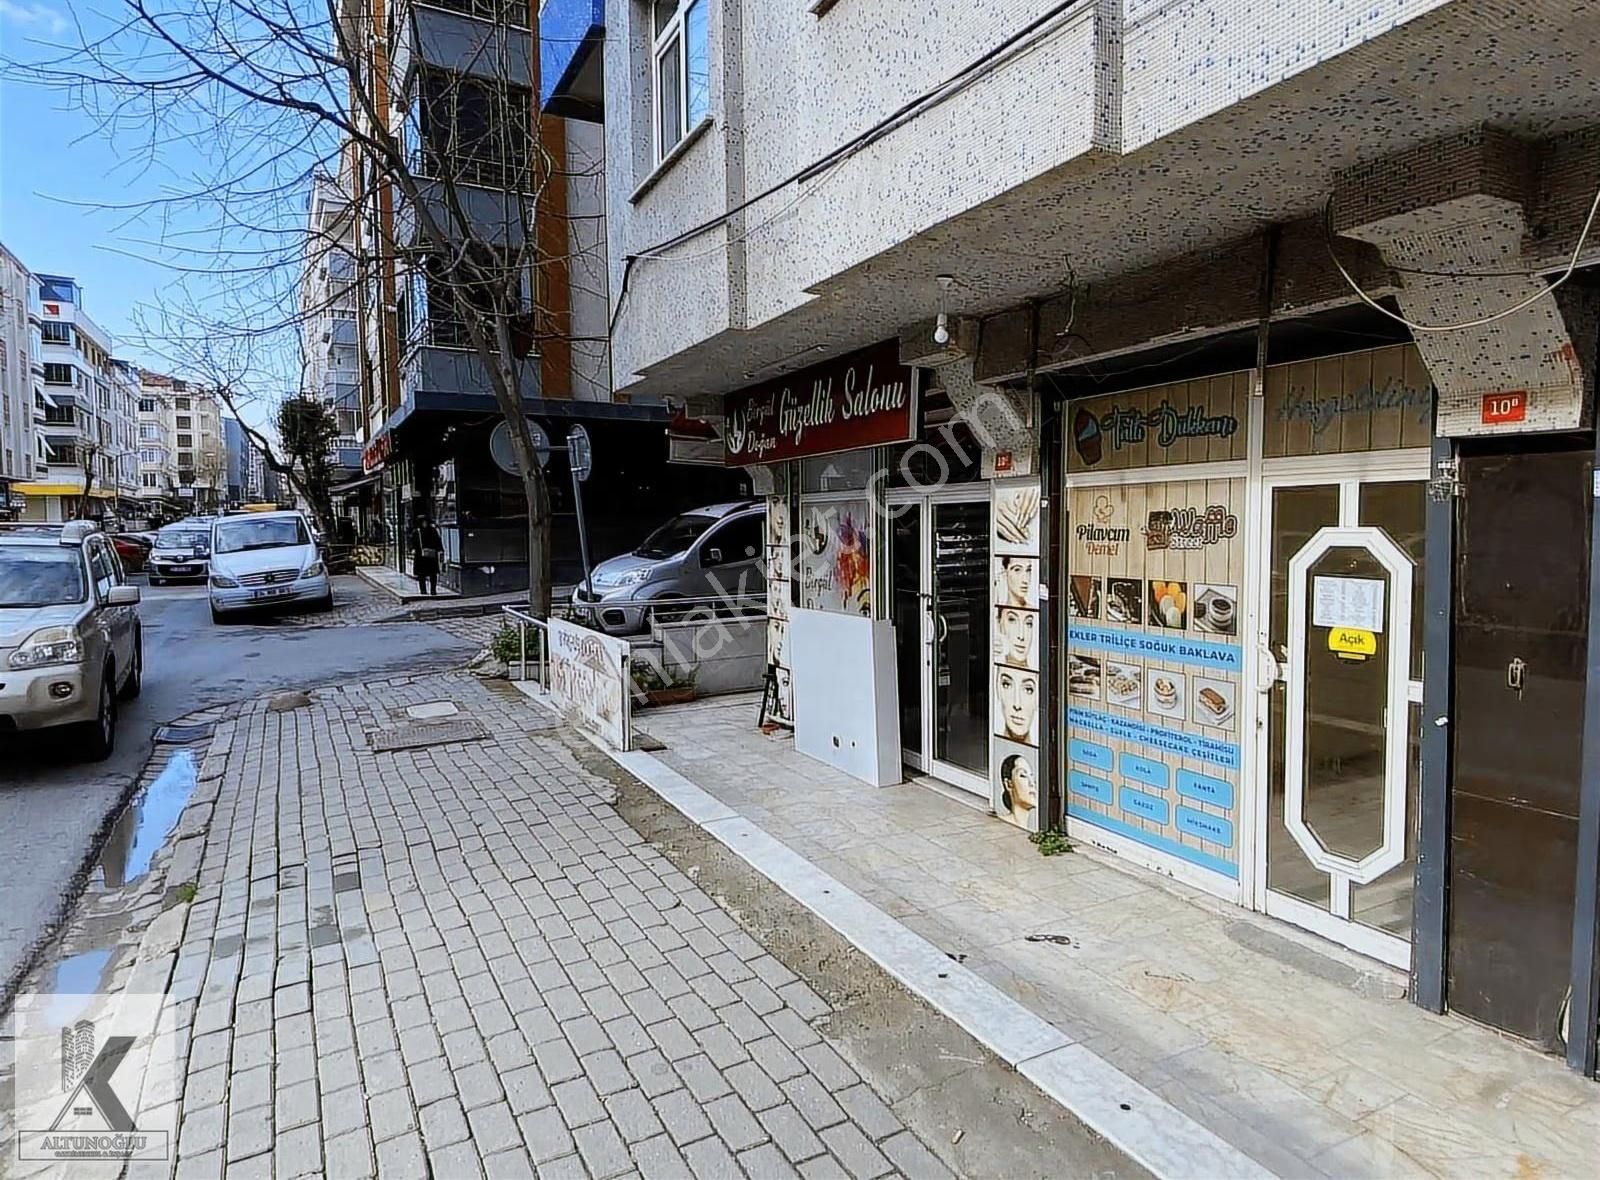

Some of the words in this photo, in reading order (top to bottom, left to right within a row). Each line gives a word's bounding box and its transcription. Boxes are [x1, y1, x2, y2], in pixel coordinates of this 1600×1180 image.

[779, 376, 835, 446] Güzellik
[842, 364, 905, 420] Salonu
[1069, 630, 1097, 642] EKLER
[1100, 634, 1136, 649] TRİLİÇE
[1139, 639, 1176, 655] SOĞUK
[1180, 646, 1235, 663] BAKLAVA
